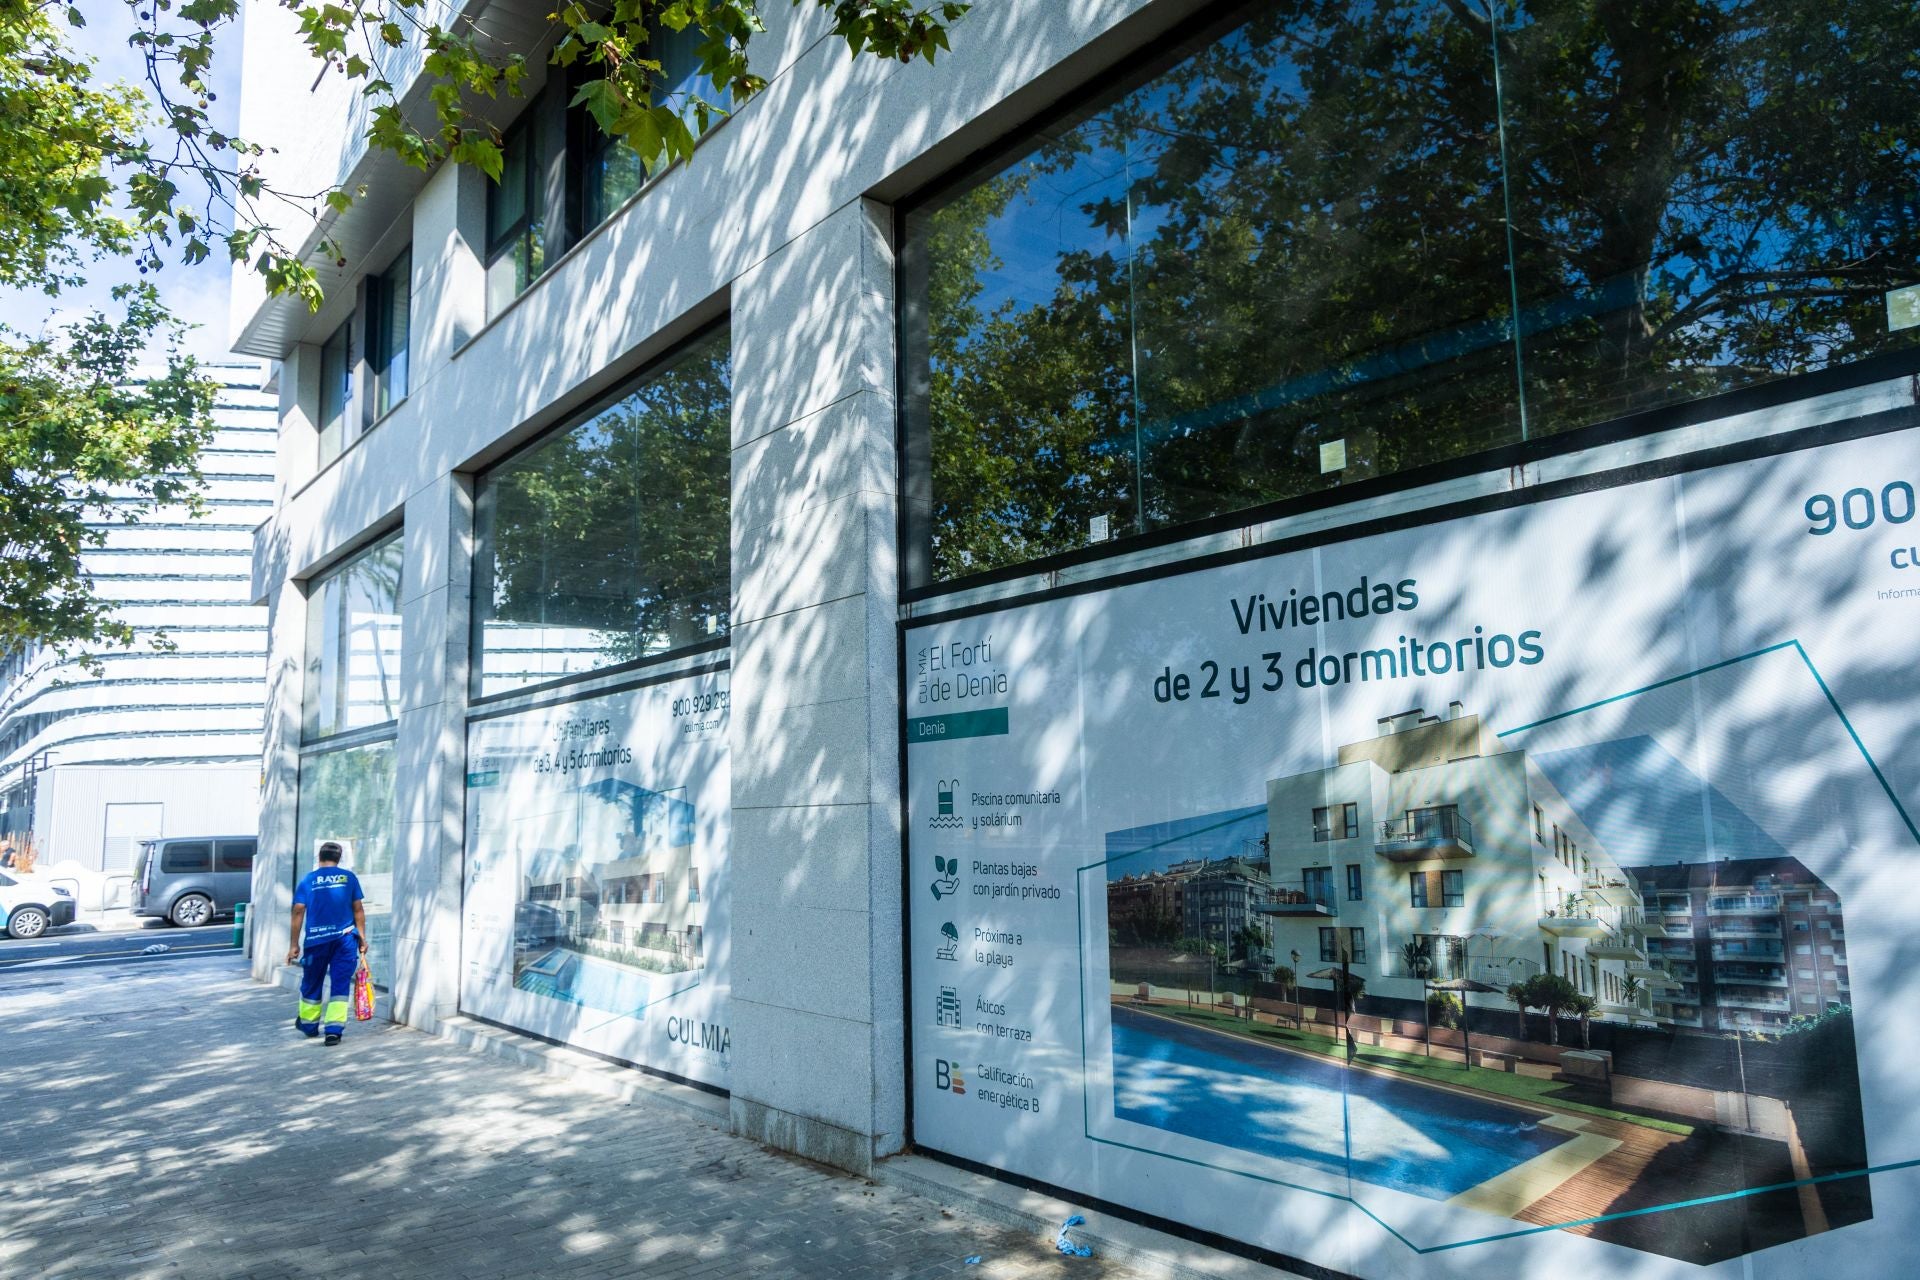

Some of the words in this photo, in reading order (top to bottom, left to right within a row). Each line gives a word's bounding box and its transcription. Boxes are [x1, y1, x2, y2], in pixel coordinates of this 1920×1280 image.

[1804, 480, 1916, 536] 900
[1230, 575, 1420, 635] Viviendas
[930, 646, 946, 672] El
[951, 635, 993, 668] Fortí
[1153, 665, 1191, 704] de
[1200, 660, 1221, 699] 2
[1231, 667, 1250, 705] y
[1262, 651, 1284, 692] 3
[1295, 625, 1545, 689] dormitorios
[918, 647, 929, 704] CULMIA
[930, 677, 951, 703] de
[957, 671, 1008, 699] Denia
[672, 697, 691, 718] 900
[692, 694, 712, 713] 929
[919, 720, 946, 736] Denia
[534, 755, 544, 773] de
[554, 752, 560, 770] 4
[562, 755, 568, 775] y
[570, 749, 576, 769] 5
[577, 744, 632, 769] dormitorios
[971, 791, 1003, 806] Piscina
[1004, 789, 1061, 805] comunitaria
[972, 816, 978, 829] y
[980, 813, 1022, 827] solárium
[973, 861, 1008, 877] Plantas
[1011, 862, 1038, 880] bajas
[973, 884, 990, 896] con
[992, 881, 1020, 899] jardín
[1022, 885, 1061, 901] privado
[974, 927, 1014, 945] Próxima
[1016, 935, 1023, 945] a
[975, 950, 984, 964] la
[986, 952, 1014, 968] playa
[976, 996, 1006, 1016] Áticos
[667, 1015, 731, 1054] CULMIA
[976, 1022, 994, 1036] con
[996, 1024, 1032, 1043] terraza
[936, 1058, 951, 1091] B
[977, 1063, 1034, 1090] Calificación
[978, 1089, 1030, 1112] energética
[1032, 1098, 1040, 1114] B
